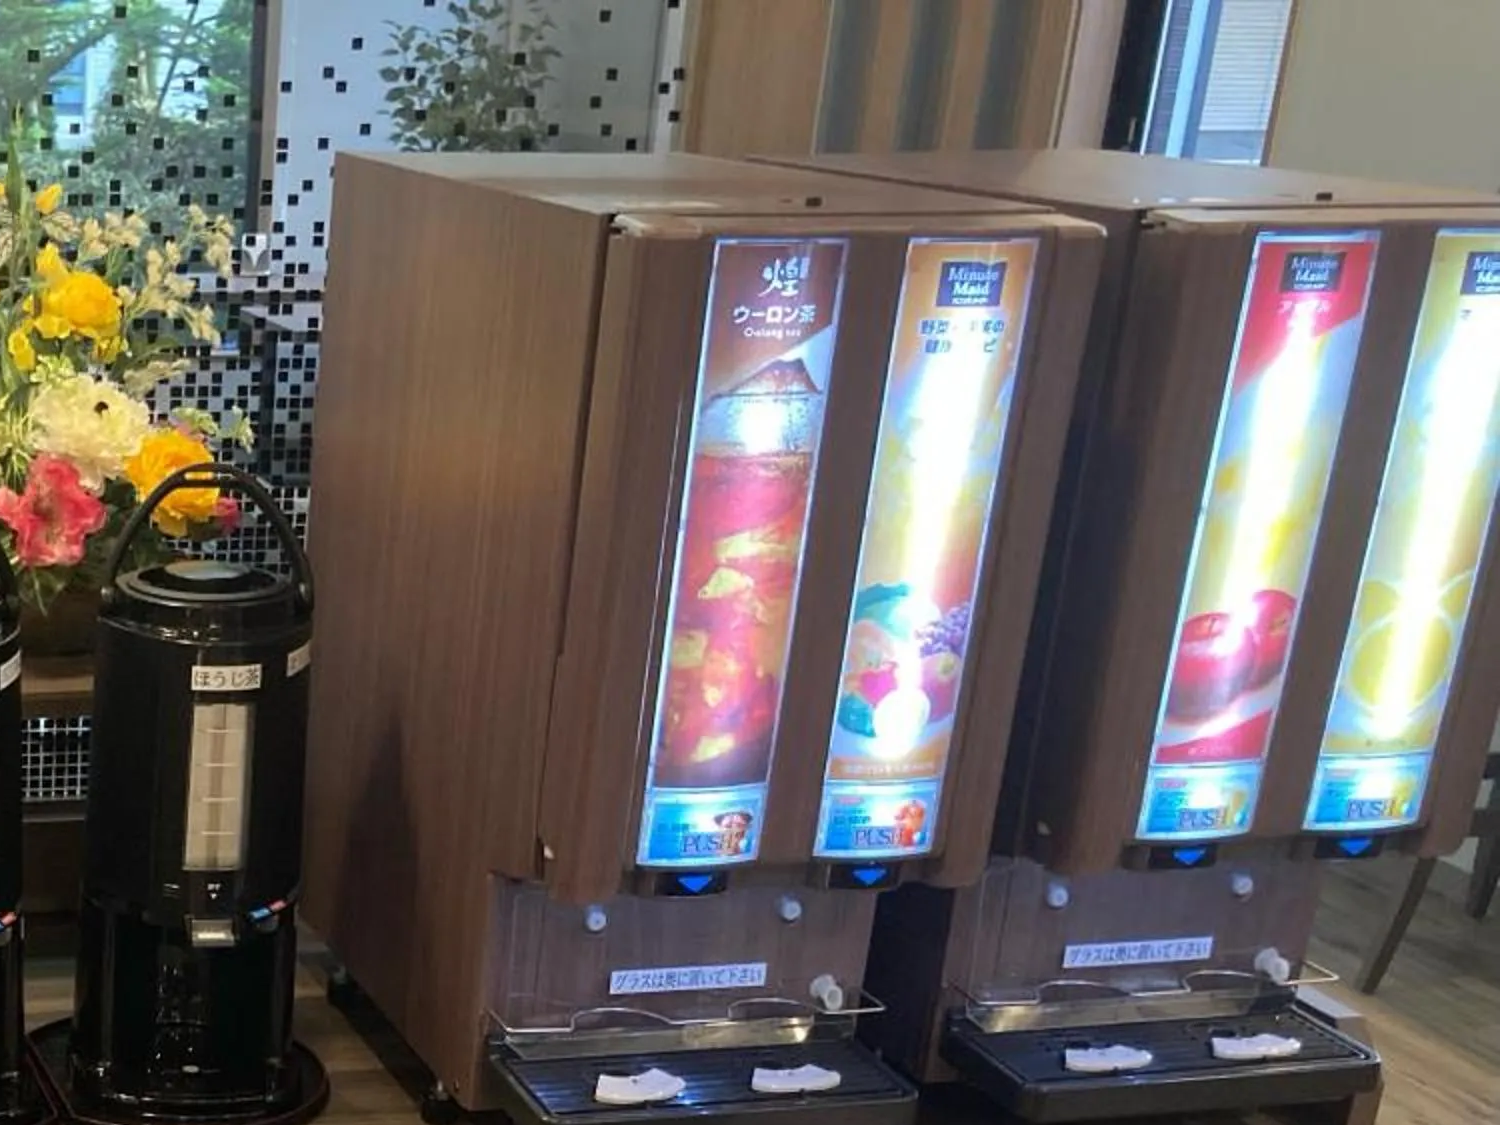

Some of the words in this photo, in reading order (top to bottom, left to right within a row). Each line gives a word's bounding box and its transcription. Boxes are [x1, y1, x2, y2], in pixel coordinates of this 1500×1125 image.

[733, 304, 817, 324] ウーロン茶
[195, 664, 260, 688] ほうじ茶
